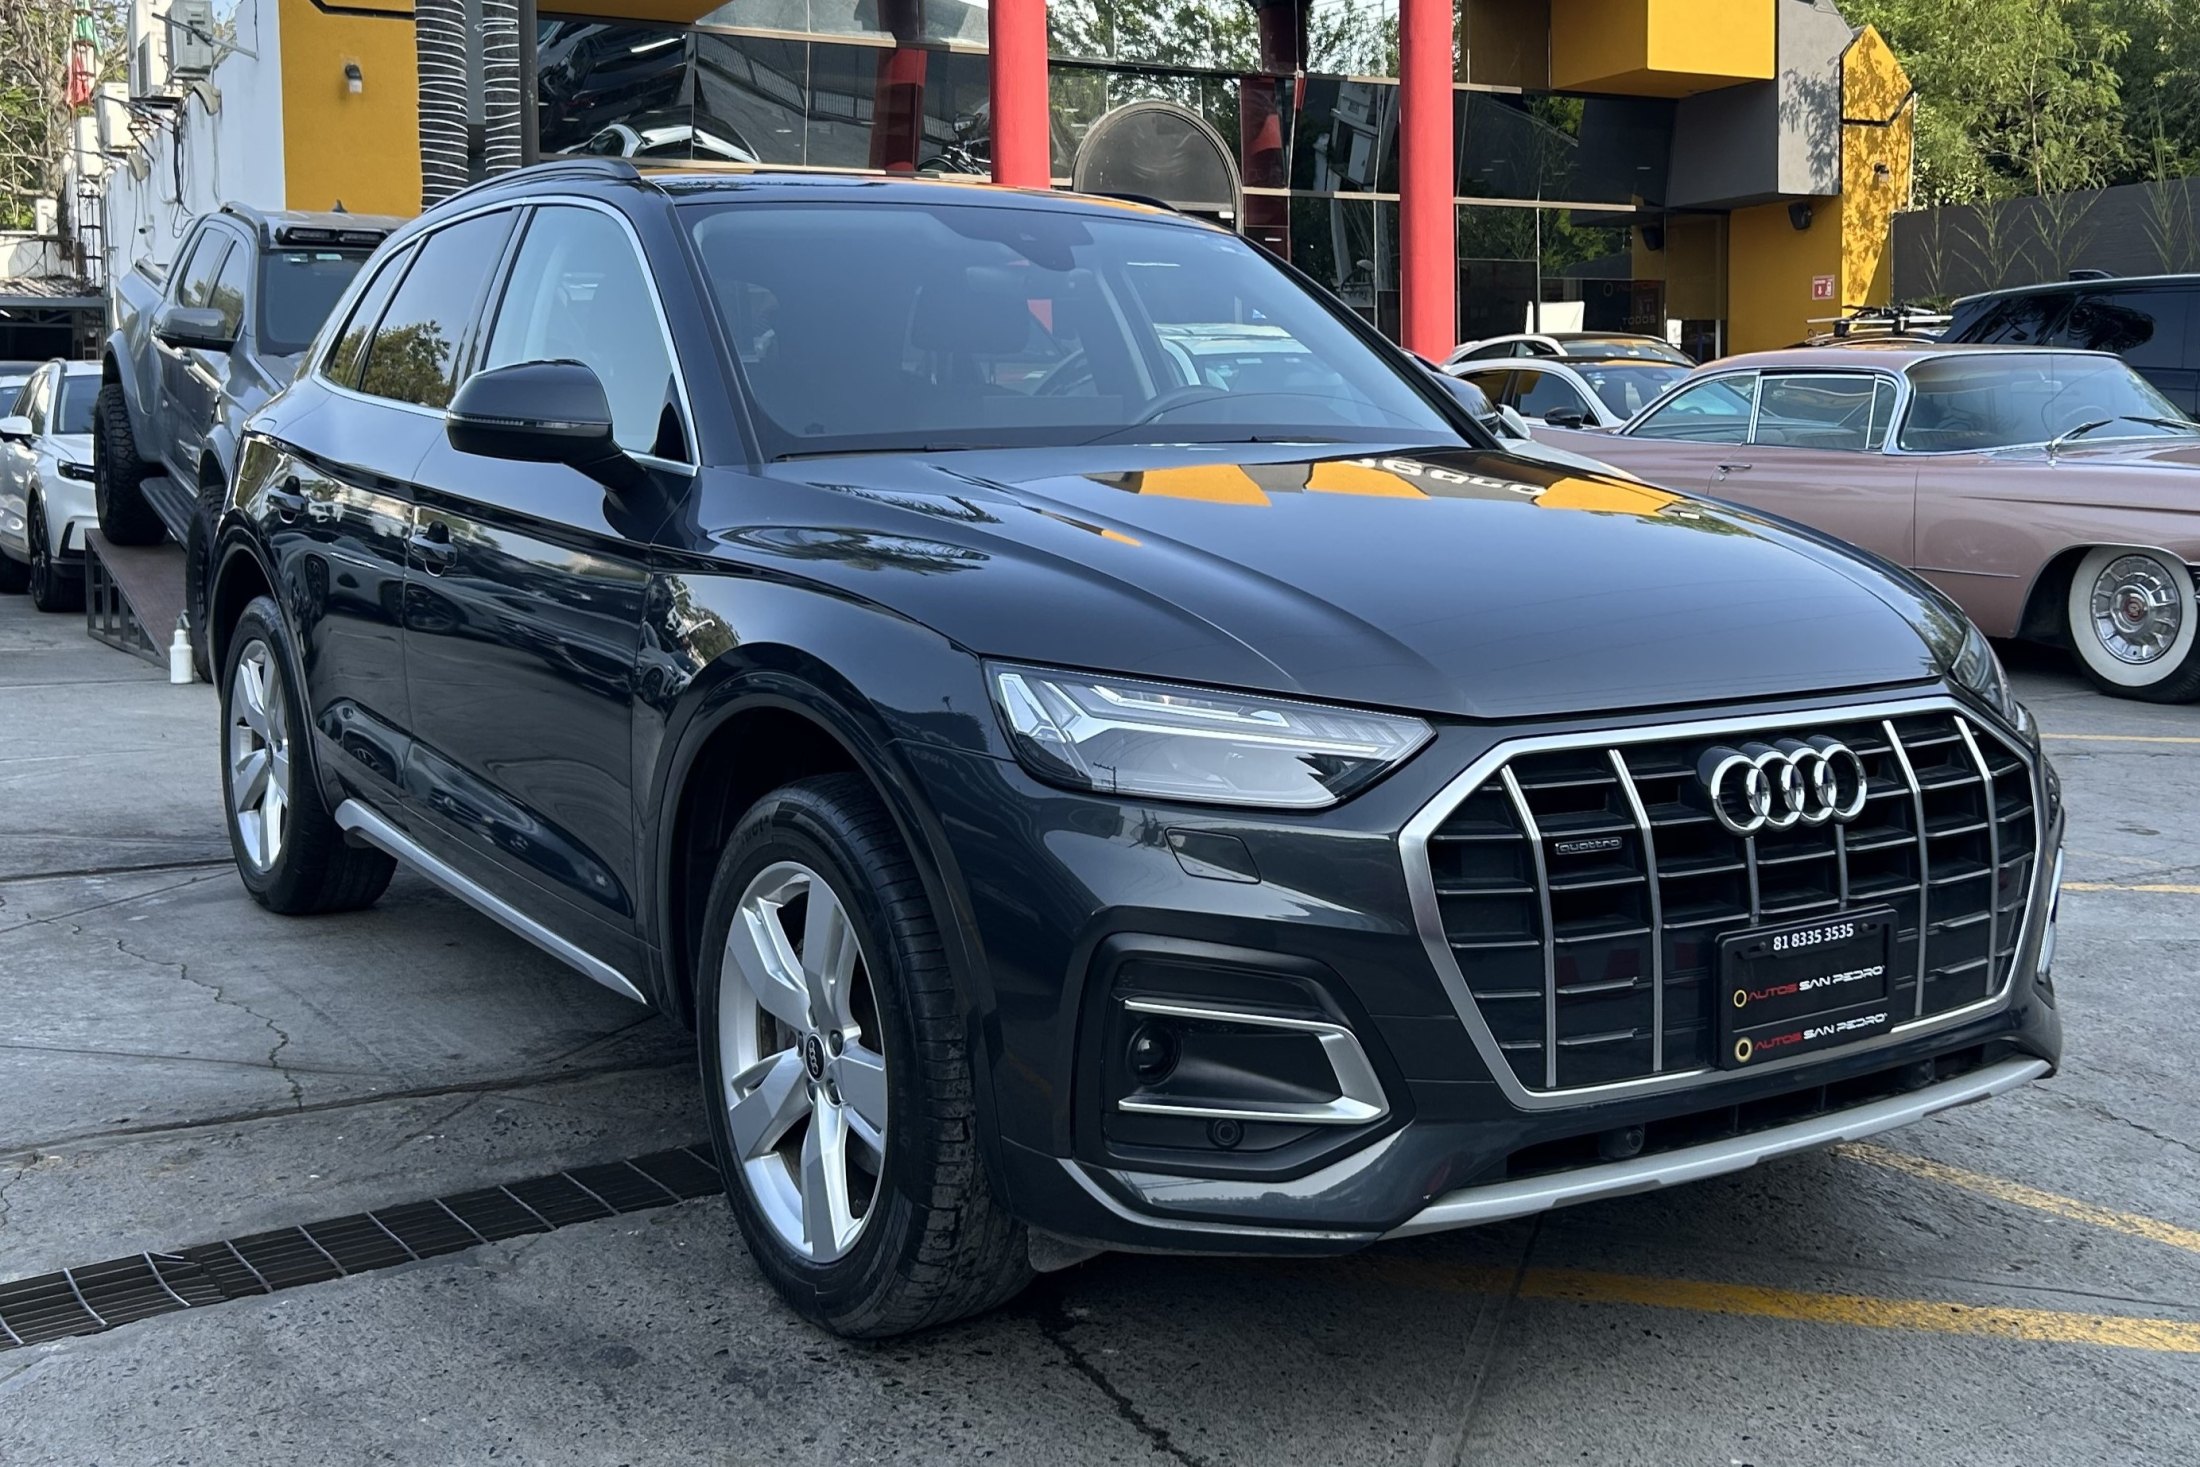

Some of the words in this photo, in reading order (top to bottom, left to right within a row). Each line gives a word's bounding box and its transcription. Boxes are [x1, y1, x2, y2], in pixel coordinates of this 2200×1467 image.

[1559, 838, 1620, 852] quattro
[1773, 935, 1789, 950] 81
[1791, 929, 1821, 948] 8335
[1824, 922, 1854, 942] 3535
[1747, 983, 1798, 1001] AUTOS
[1799, 975, 1831, 991] SAN
[1832, 965, 1884, 984] PEDRO
[1754, 1032, 1802, 1050] AUTOS
[1803, 1024, 1835, 1040] SAN
[1836, 1014, 1885, 1033] PEDRO
